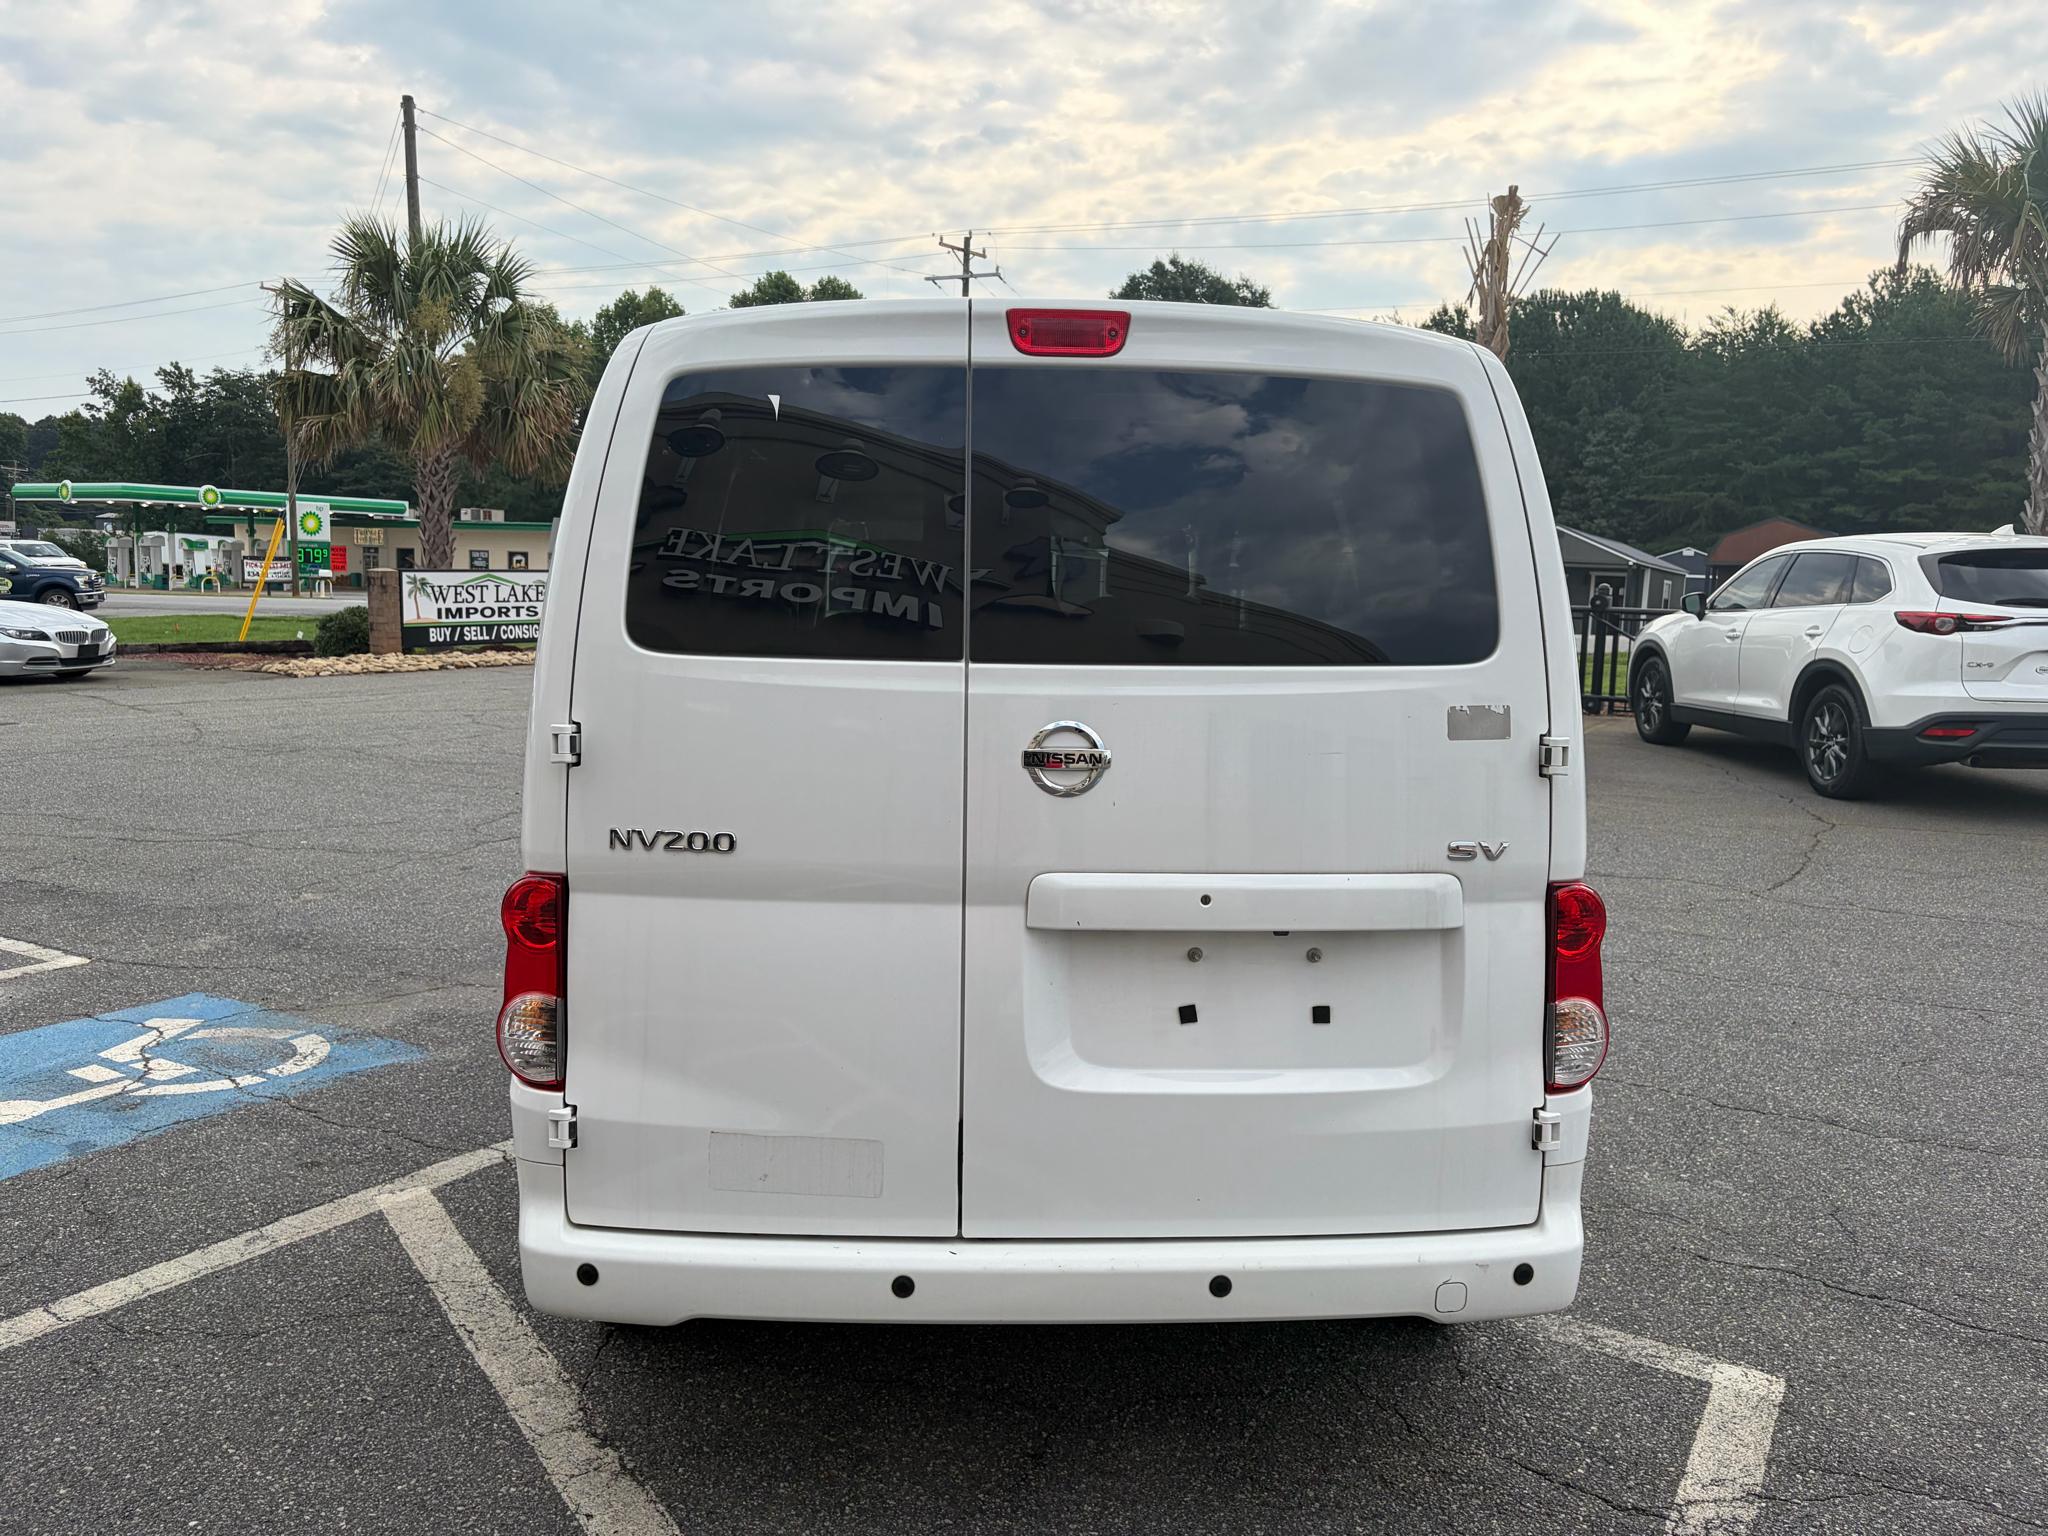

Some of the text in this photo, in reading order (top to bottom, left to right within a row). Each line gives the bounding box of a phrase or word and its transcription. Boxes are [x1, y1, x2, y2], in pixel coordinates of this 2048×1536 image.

[429, 584, 545, 605] WEST LAKE
[437, 605, 539, 620] IMPORTS
[429, 627, 452, 643] BUY
[464, 625, 490, 641] SELL
[1031, 753, 1102, 766] NISSAN
[609, 828, 737, 853] NV200
[1447, 841, 1511, 861] SV
